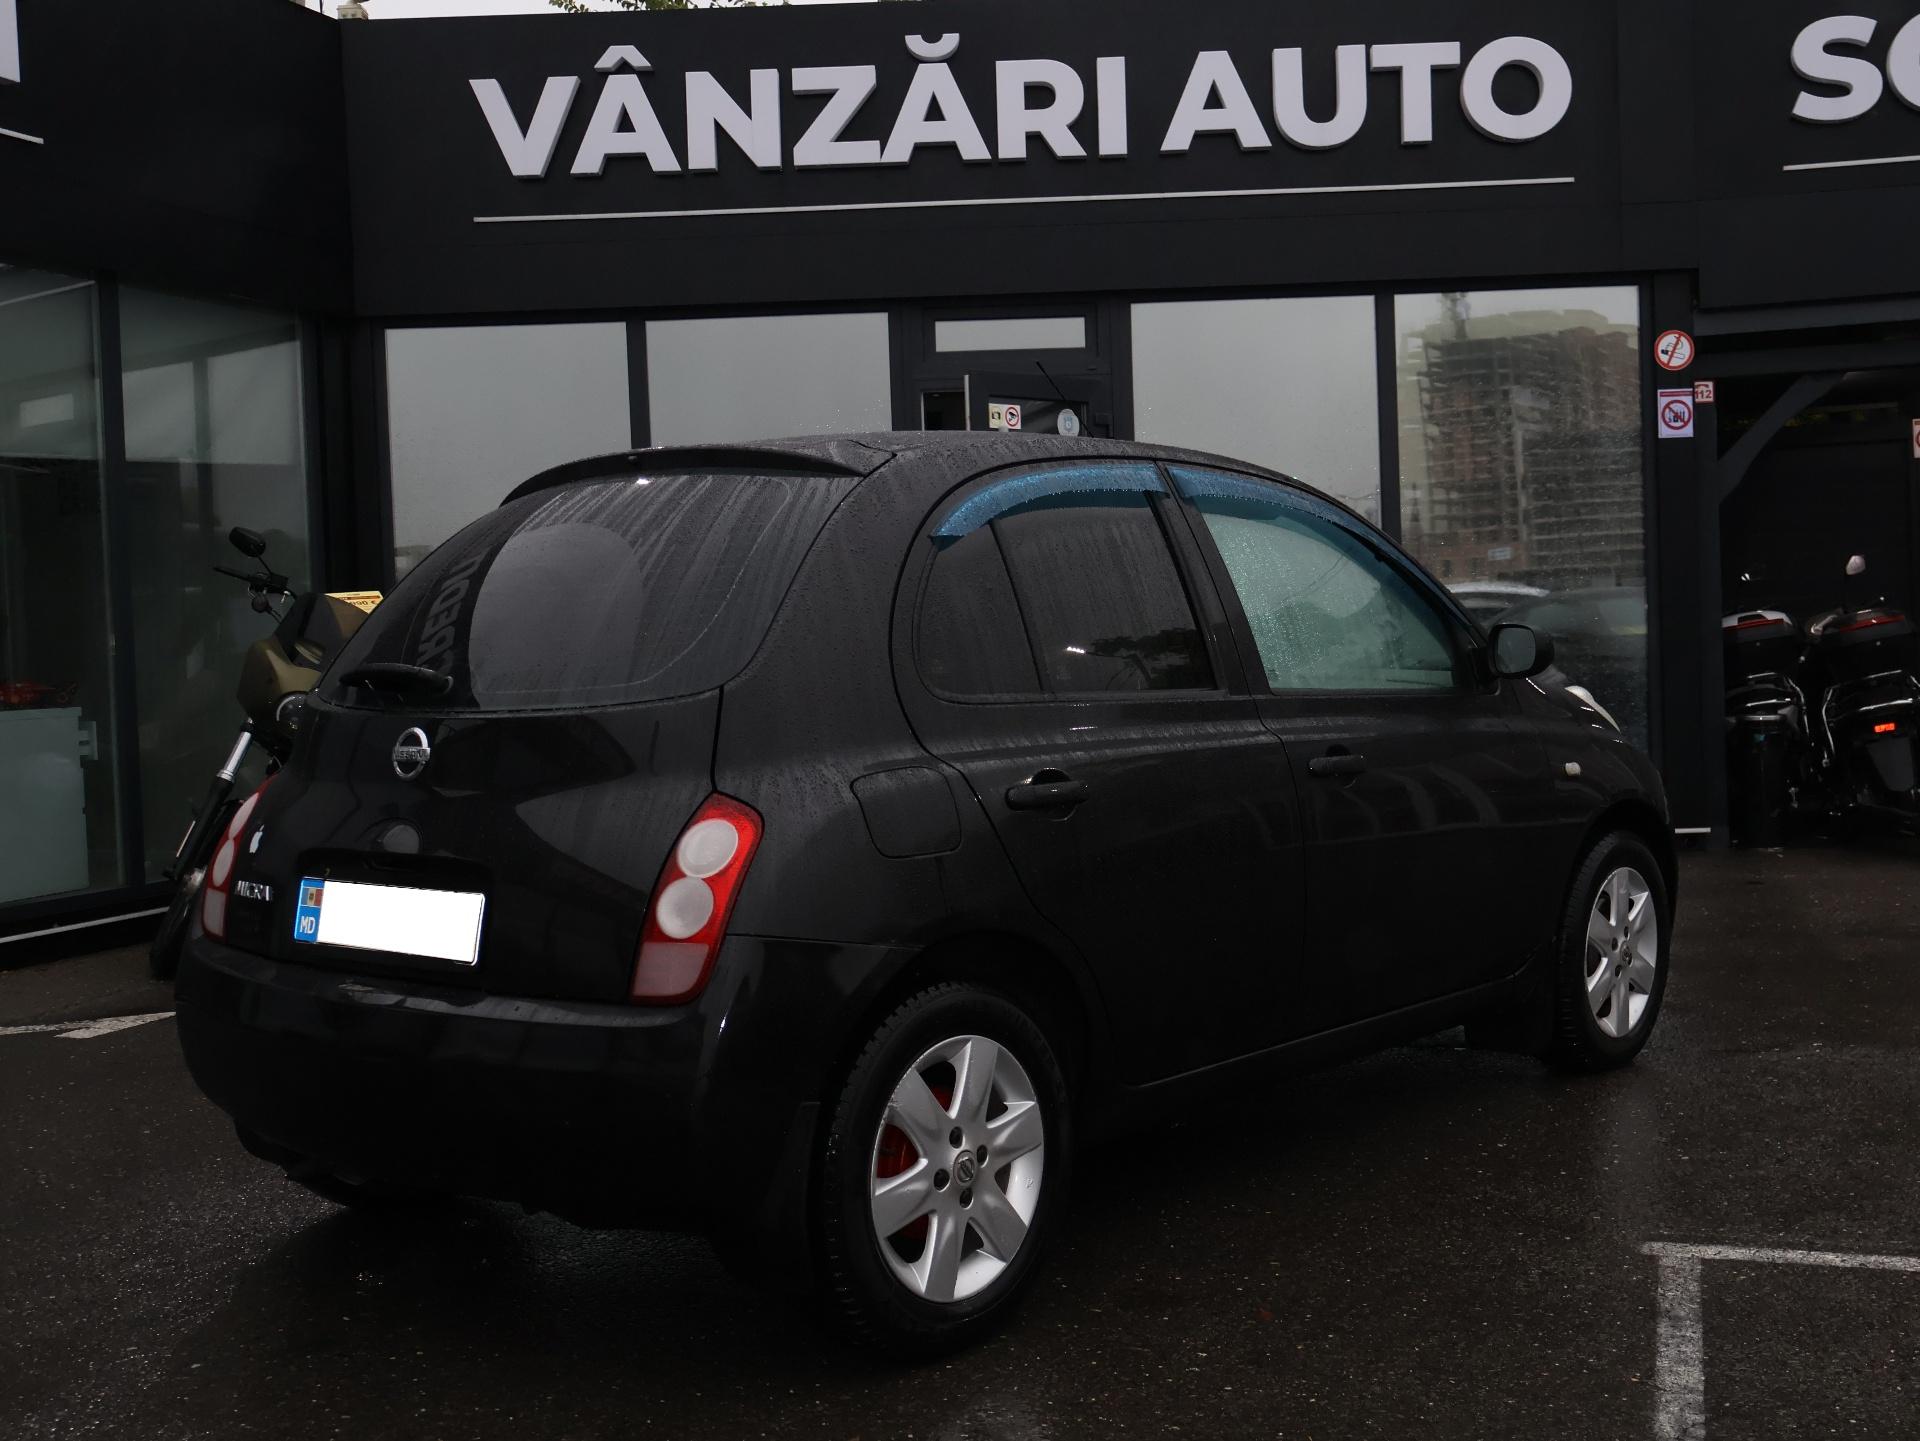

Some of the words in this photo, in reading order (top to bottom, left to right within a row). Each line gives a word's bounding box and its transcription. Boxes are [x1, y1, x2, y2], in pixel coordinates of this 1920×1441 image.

[468, 32, 1128, 179] VÂNZĂRI
[1159, 35, 1574, 153] AUTO
[1694, 389, 1712, 400] 112
[299, 915, 317, 934] MD
